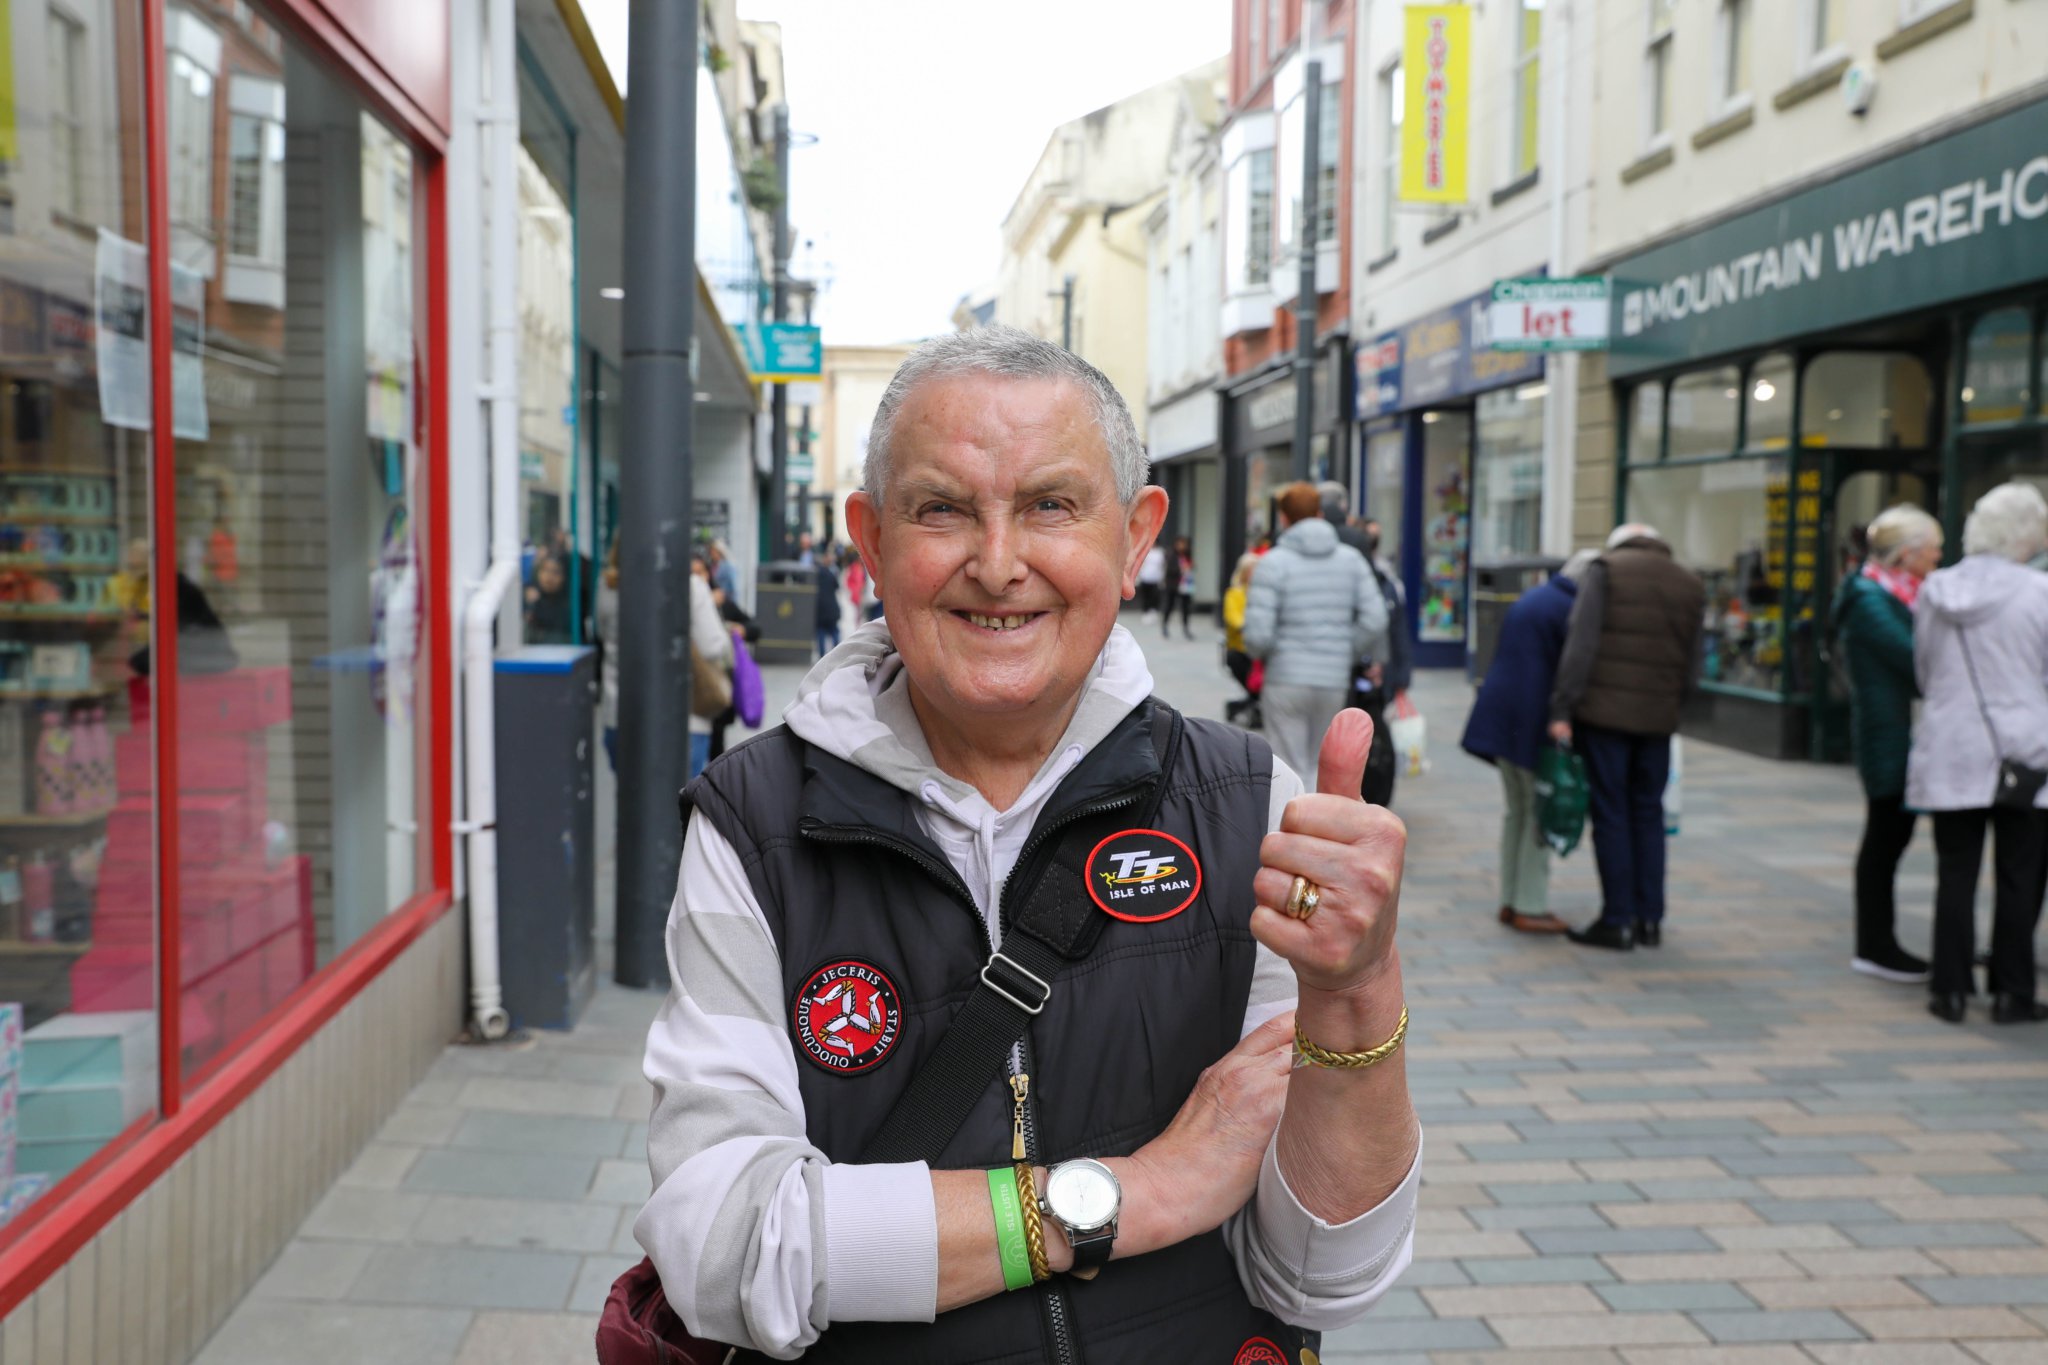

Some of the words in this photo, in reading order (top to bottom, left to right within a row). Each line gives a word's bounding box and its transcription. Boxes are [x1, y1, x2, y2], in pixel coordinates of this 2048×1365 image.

[1426, 17, 1447, 188] TOYMASTER
[1644, 232, 1823, 328] MOUNTAIN
[1522, 304, 1575, 338] let
[1109, 850, 1175, 884] TT
[1109, 887, 1135, 900] ISLE
[1140, 884, 1156, 894] OF
[1160, 879, 1190, 892] MAN
[822, 966, 880, 985] JECERIS
[798, 997, 849, 1068] QUOCUNQUE
[873, 1009, 898, 1056] STABIT
[1000, 1183, 1012, 1210] LISTEN
[1006, 1212, 1015, 1232] ISLE
